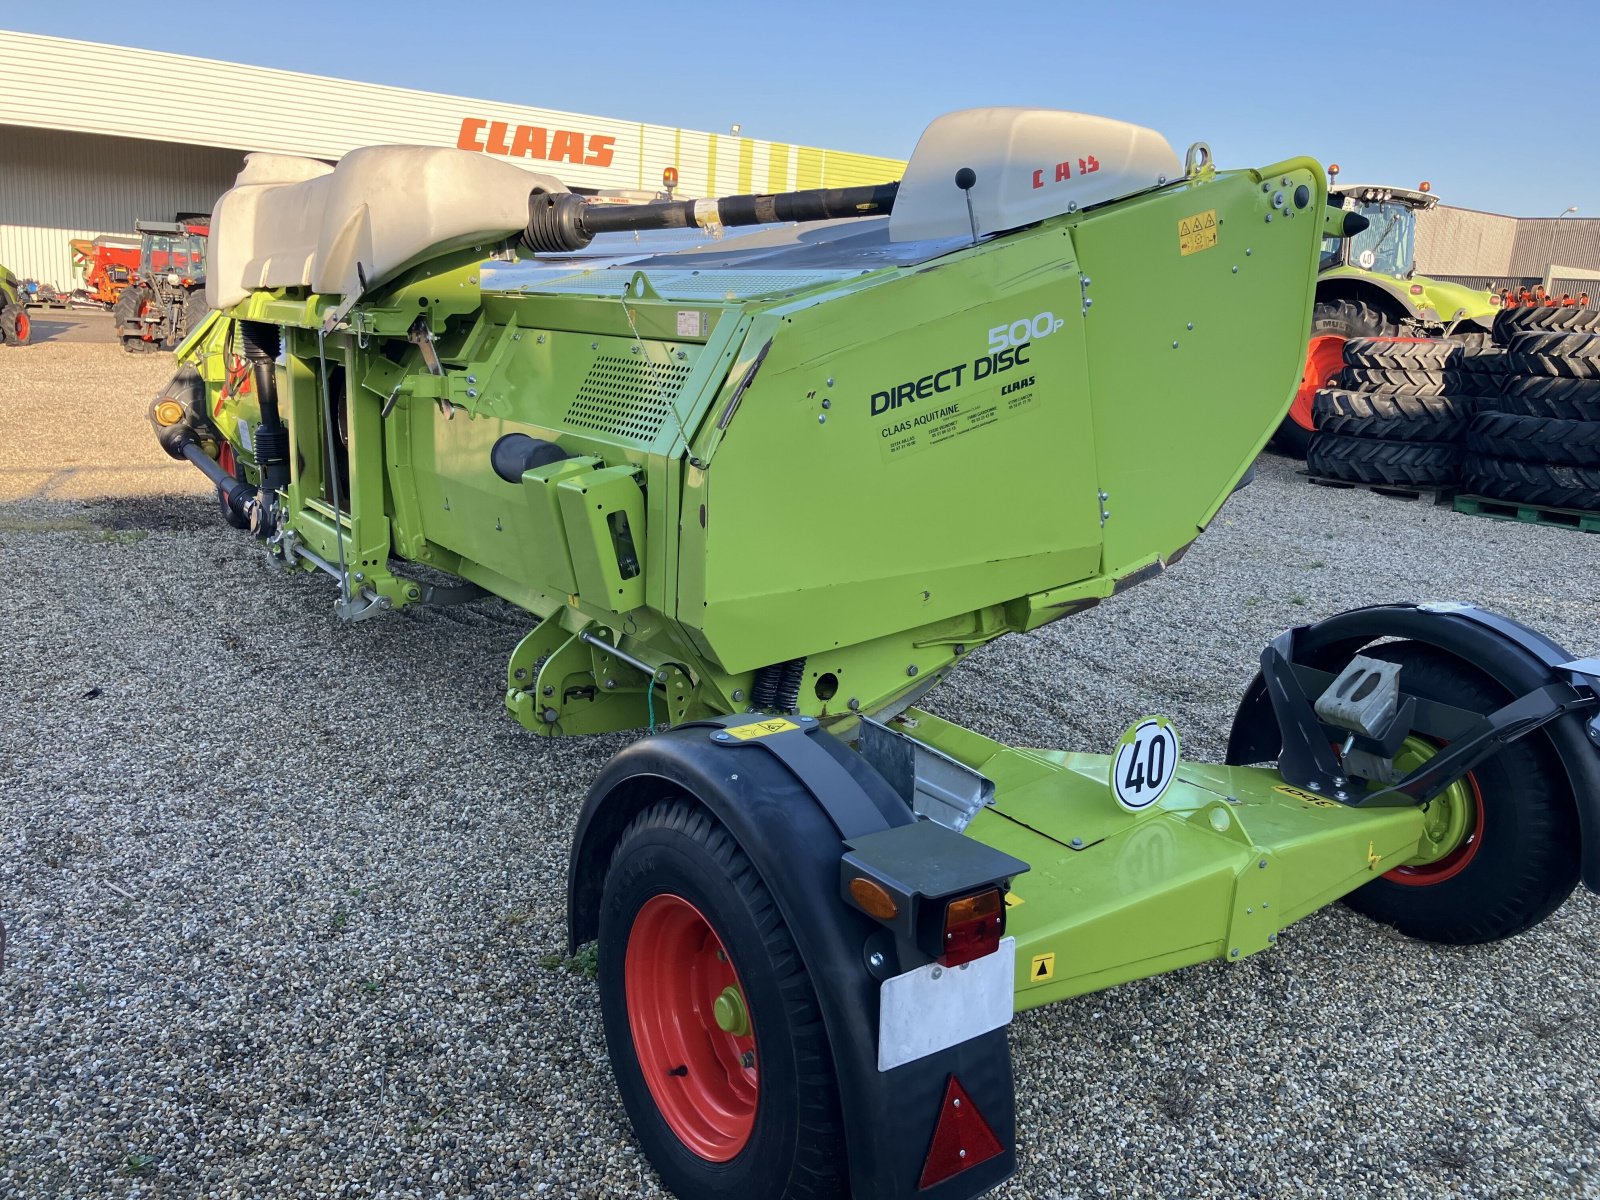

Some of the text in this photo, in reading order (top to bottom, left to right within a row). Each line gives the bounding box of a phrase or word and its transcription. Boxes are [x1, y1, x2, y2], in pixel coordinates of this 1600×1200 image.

[457, 117, 616, 168] CLAAS
[870, 342, 1031, 417] DIRECT DISC
[1001, 375, 1035, 396] CLAAS
[881, 420, 912, 438] CLAAS
[913, 403, 960, 428] AQUITAINE
[1125, 735, 1166, 794] 40
